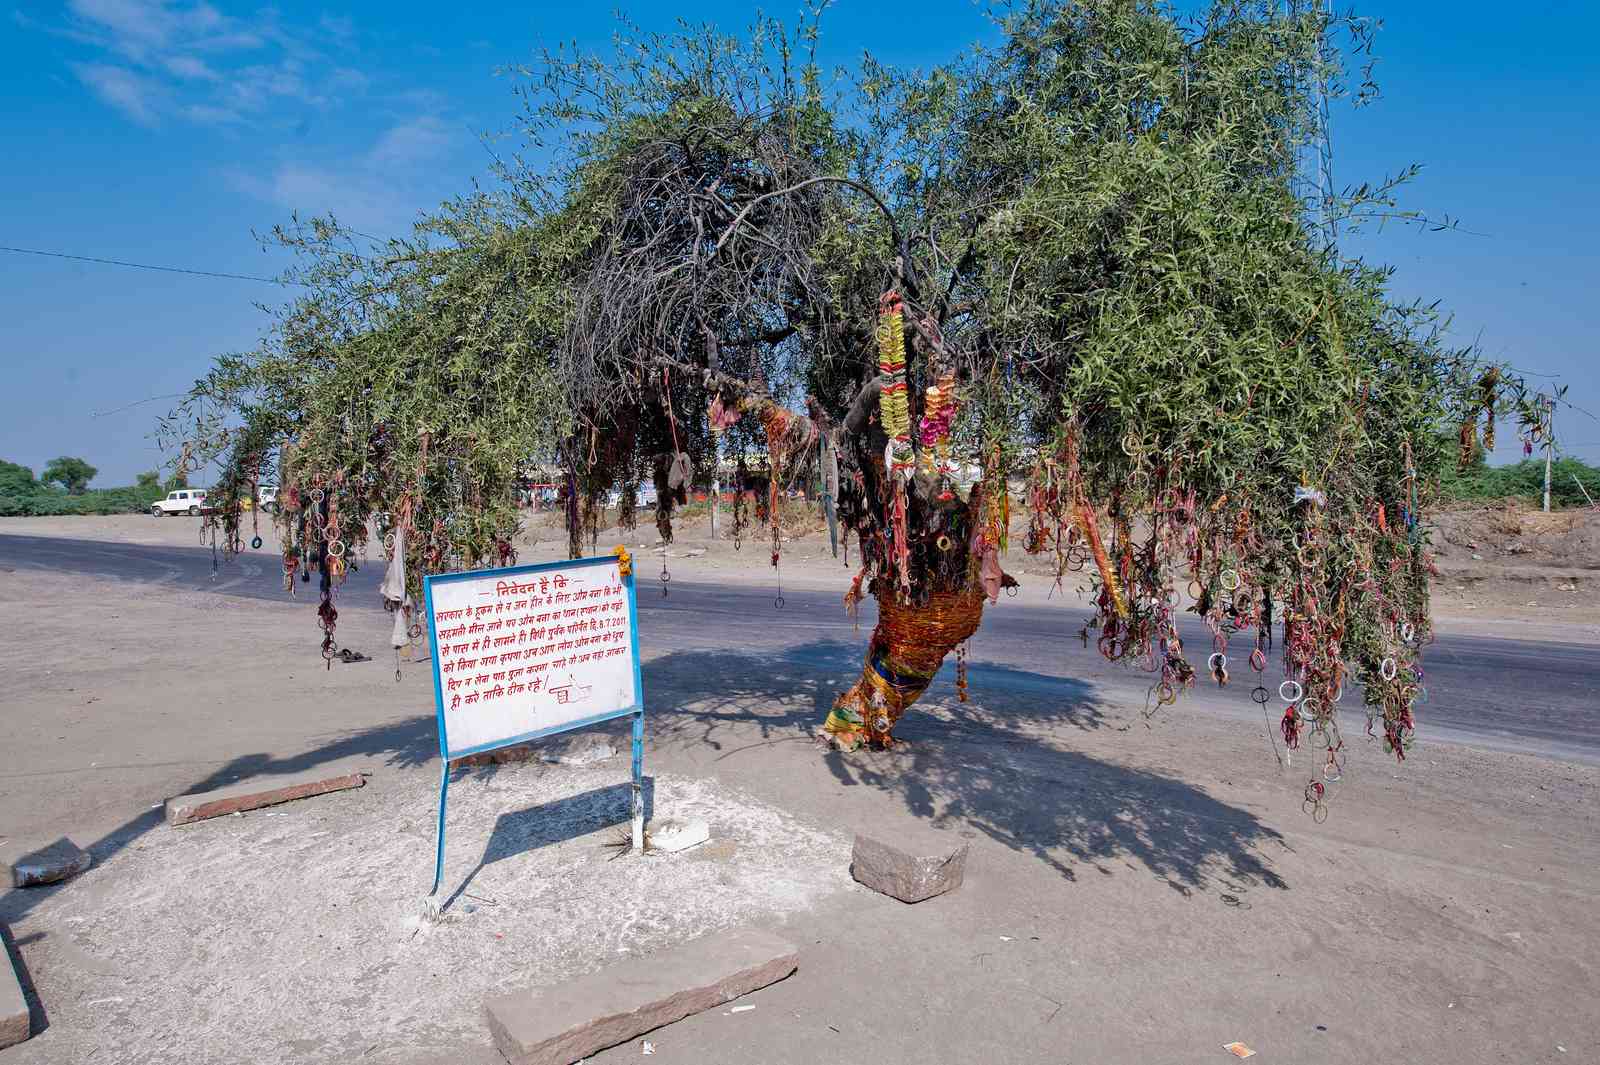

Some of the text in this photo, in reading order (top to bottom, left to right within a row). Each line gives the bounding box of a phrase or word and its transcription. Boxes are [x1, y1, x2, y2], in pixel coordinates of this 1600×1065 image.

[496, 581, 536, 596] निवेदन
[554, 575, 569, 589] कि
[437, 610, 463, 623] सरकार
[467, 605, 473, 616] के
[495, 602, 503, 614] से
[514, 600, 527, 609] जन
[547, 595, 552, 604] के
[487, 619, 502, 630] जाने
[518, 614, 534, 627] ओम
[441, 645, 450, 657] से
[453, 643, 468, 654] पास
[482, 636, 490, 650] ही
[494, 634, 515, 647] सामने
[518, 631, 526, 645] ही
[443, 660, 454, 672] को
[457, 657, 478, 670] किया
[539, 646, 554, 658] आप
[493, 672, 504, 681] पाठ
[450, 695, 461, 710] ही
[483, 685, 504, 701] ताकि
